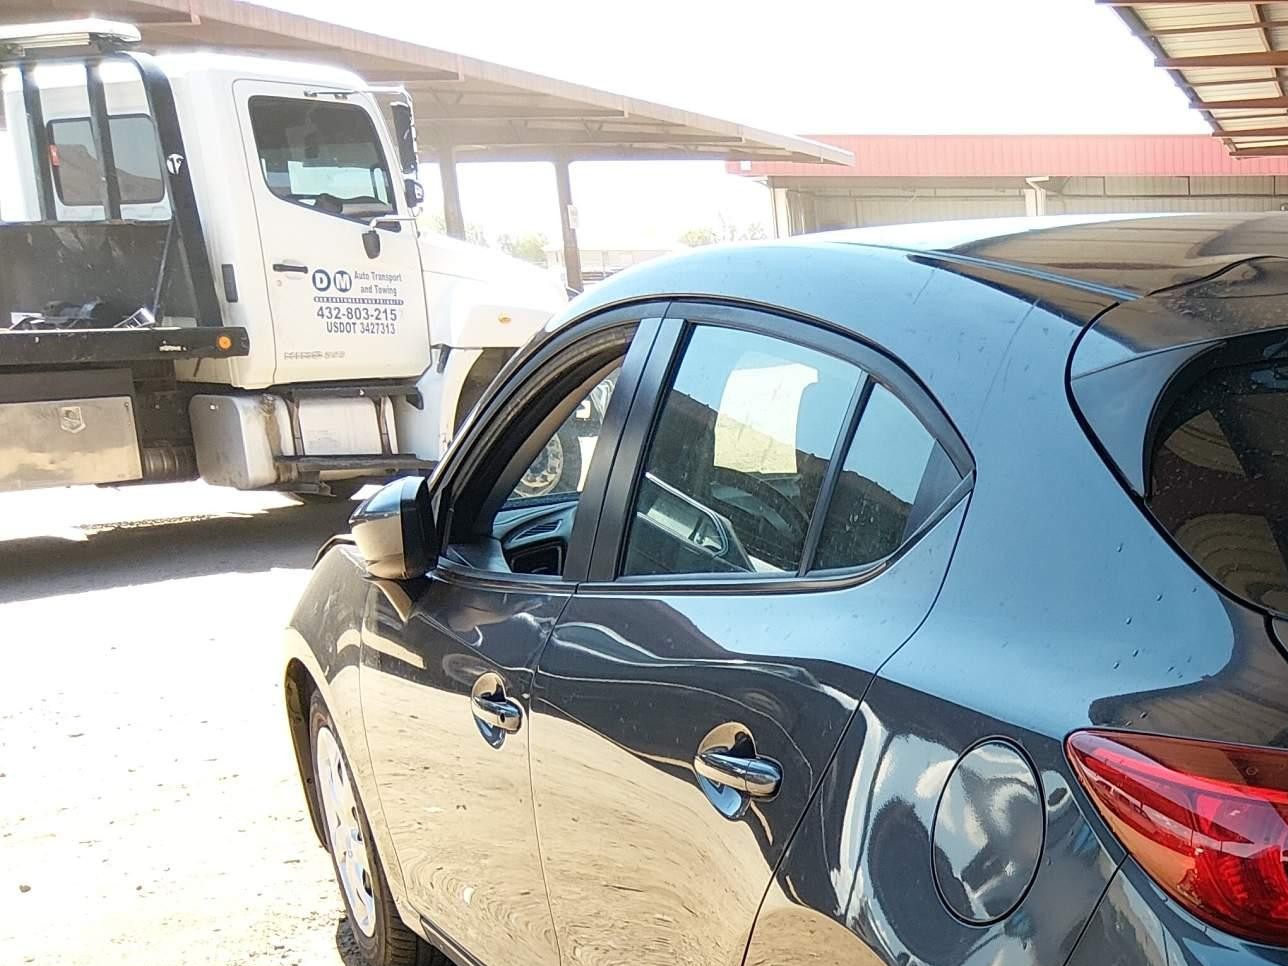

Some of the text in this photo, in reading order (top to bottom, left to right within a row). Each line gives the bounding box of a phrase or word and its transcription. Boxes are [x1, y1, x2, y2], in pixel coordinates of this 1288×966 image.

[354, 271, 402, 282] Auto Transport
[360, 285, 397, 297] and Towing
[326, 321, 396, 335] USDOT 3427313
